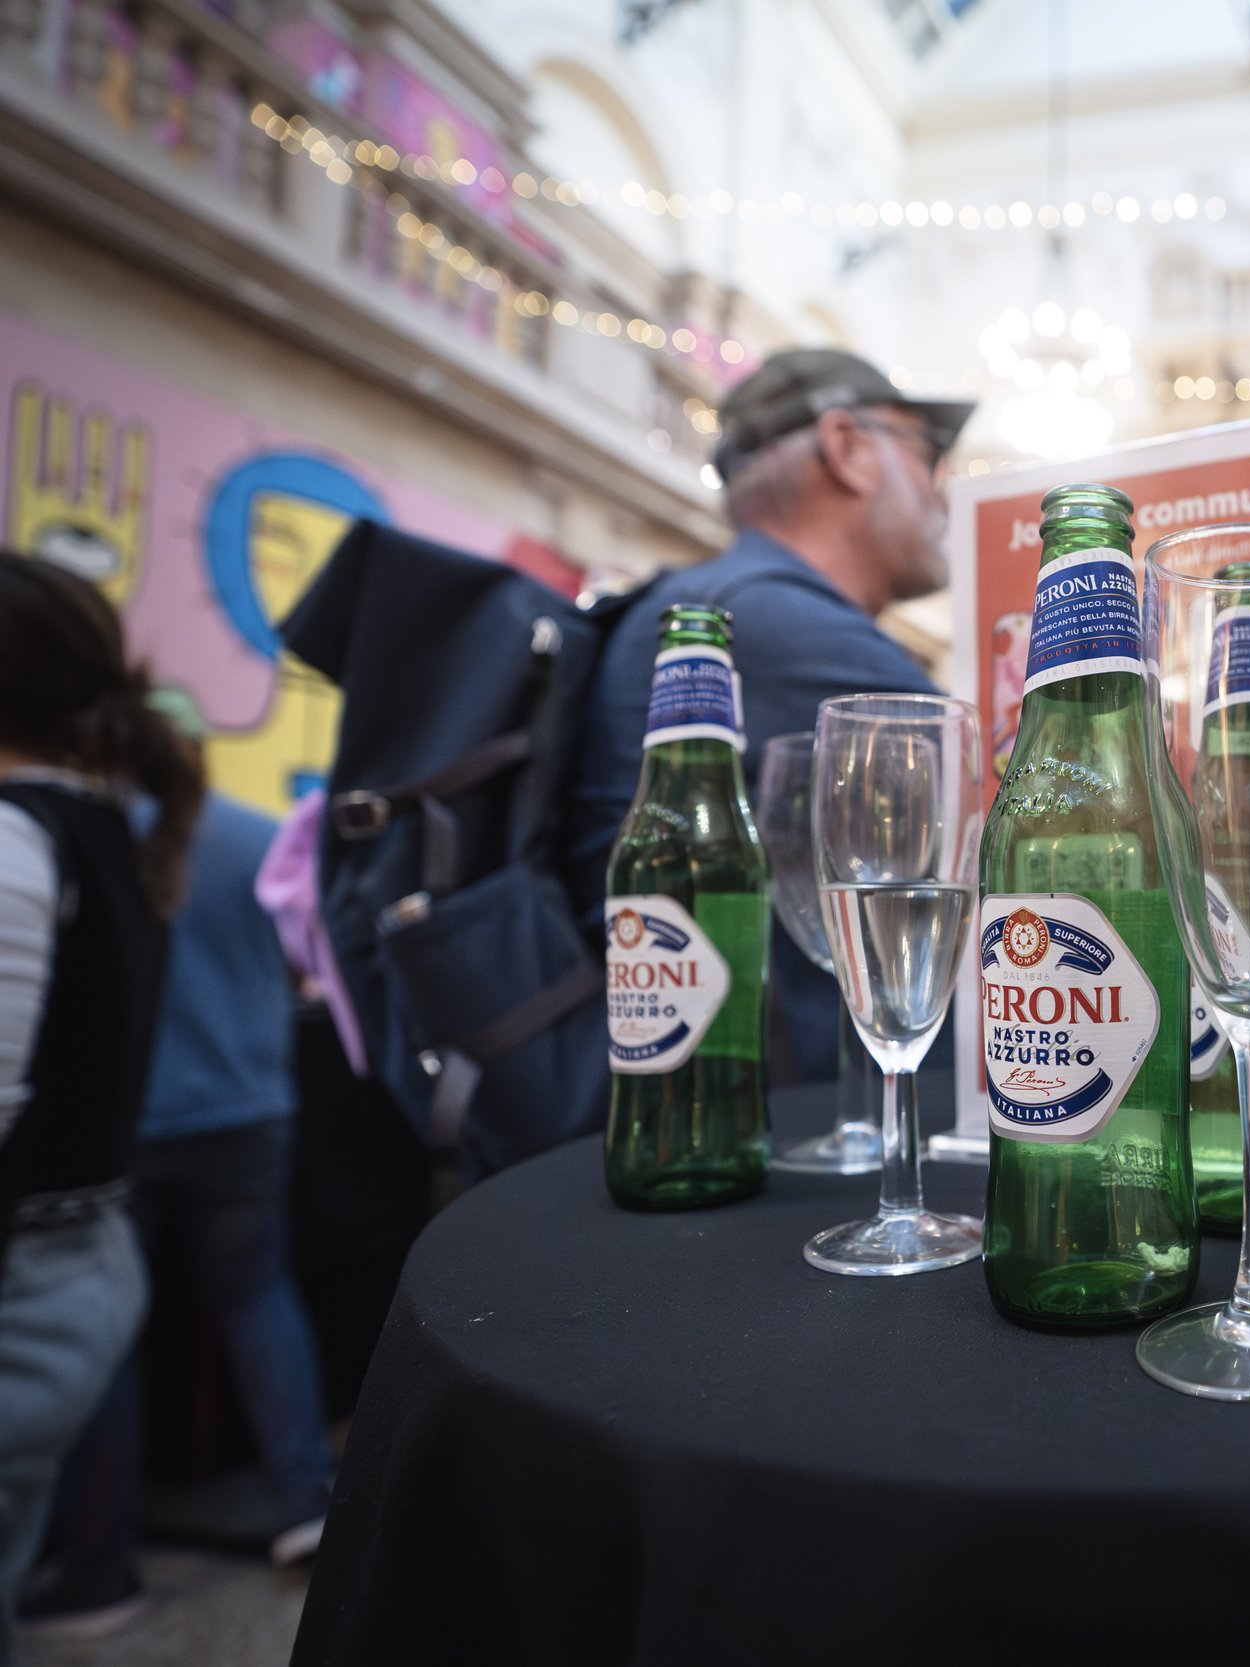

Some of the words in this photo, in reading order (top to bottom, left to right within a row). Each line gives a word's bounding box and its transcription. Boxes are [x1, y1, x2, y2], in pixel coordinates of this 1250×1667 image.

[1007, 519, 1042, 550] Jo
[1034, 574, 1098, 613] PERONI
[1108, 573, 1135, 588] NASTRO
[1101, 581, 1137, 597] AZZURR
[1044, 606, 1070, 620] GUSTO
[1107, 600, 1131, 609] SECCO
[1032, 617, 1078, 641] RINFRESCANTE
[1080, 612, 1107, 621] DELLA
[1108, 612, 1129, 620] BIRRA
[1034, 633, 1063, 649] ITALIANA
[1065, 627, 1080, 637] PIÙ
[1082, 624, 1115, 634] BEVUTA
[1004, 918, 1015, 951] BIRRA
[1033, 918, 1048, 954] PERONI
[1053, 928, 1108, 962] SUPERIORE
[1012, 954, 1038, 965] ROMA
[607, 961, 699, 990] ERONI
[1003, 971, 1021, 981] DAL
[1024, 972, 1050, 982] 1846
[994, 1026, 1070, 1046] NASTRO
[987, 1041, 1095, 1067] AZZURRO
[997, 1098, 1067, 1119] ITALIANA
